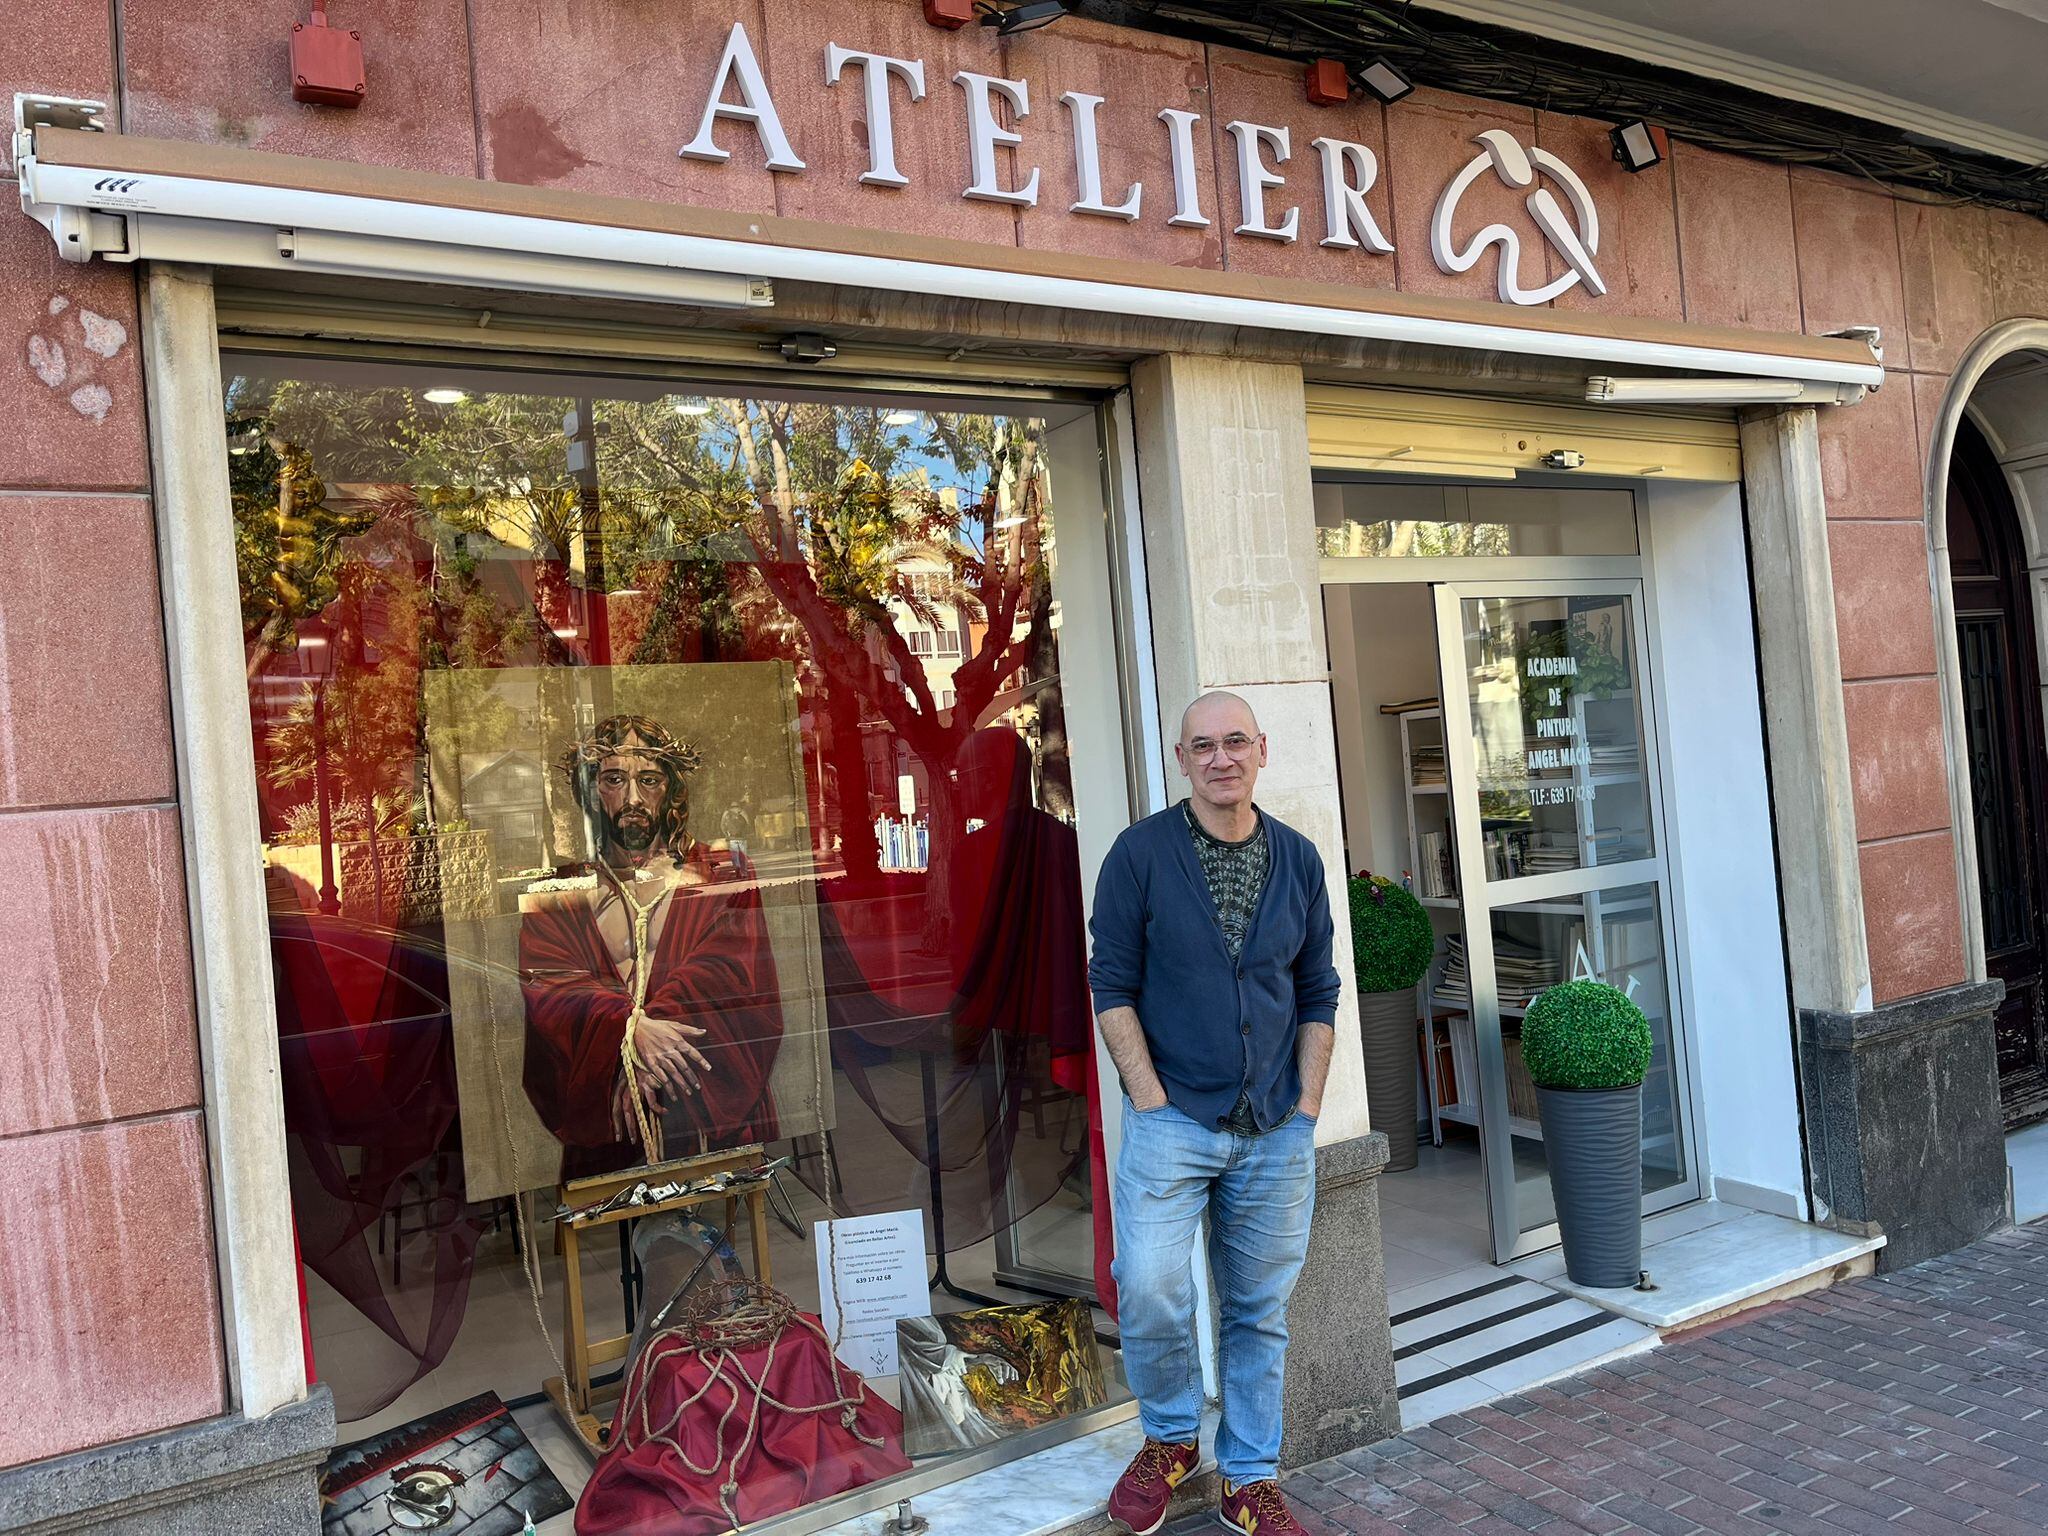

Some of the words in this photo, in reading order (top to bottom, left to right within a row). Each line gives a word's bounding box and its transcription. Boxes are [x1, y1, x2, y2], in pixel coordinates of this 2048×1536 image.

[679, 22, 1394, 255] ATELIER
[1527, 657, 1578, 677] ACADEMIA
[1548, 688, 1562, 706] DE
[1536, 717, 1578, 738] PINTURA
[1528, 749, 1560, 770] ANGEL
[1529, 788, 1550, 806] TLF.:
[1550, 787, 1565, 804] 639
[1565, 786, 1574, 803] 17
